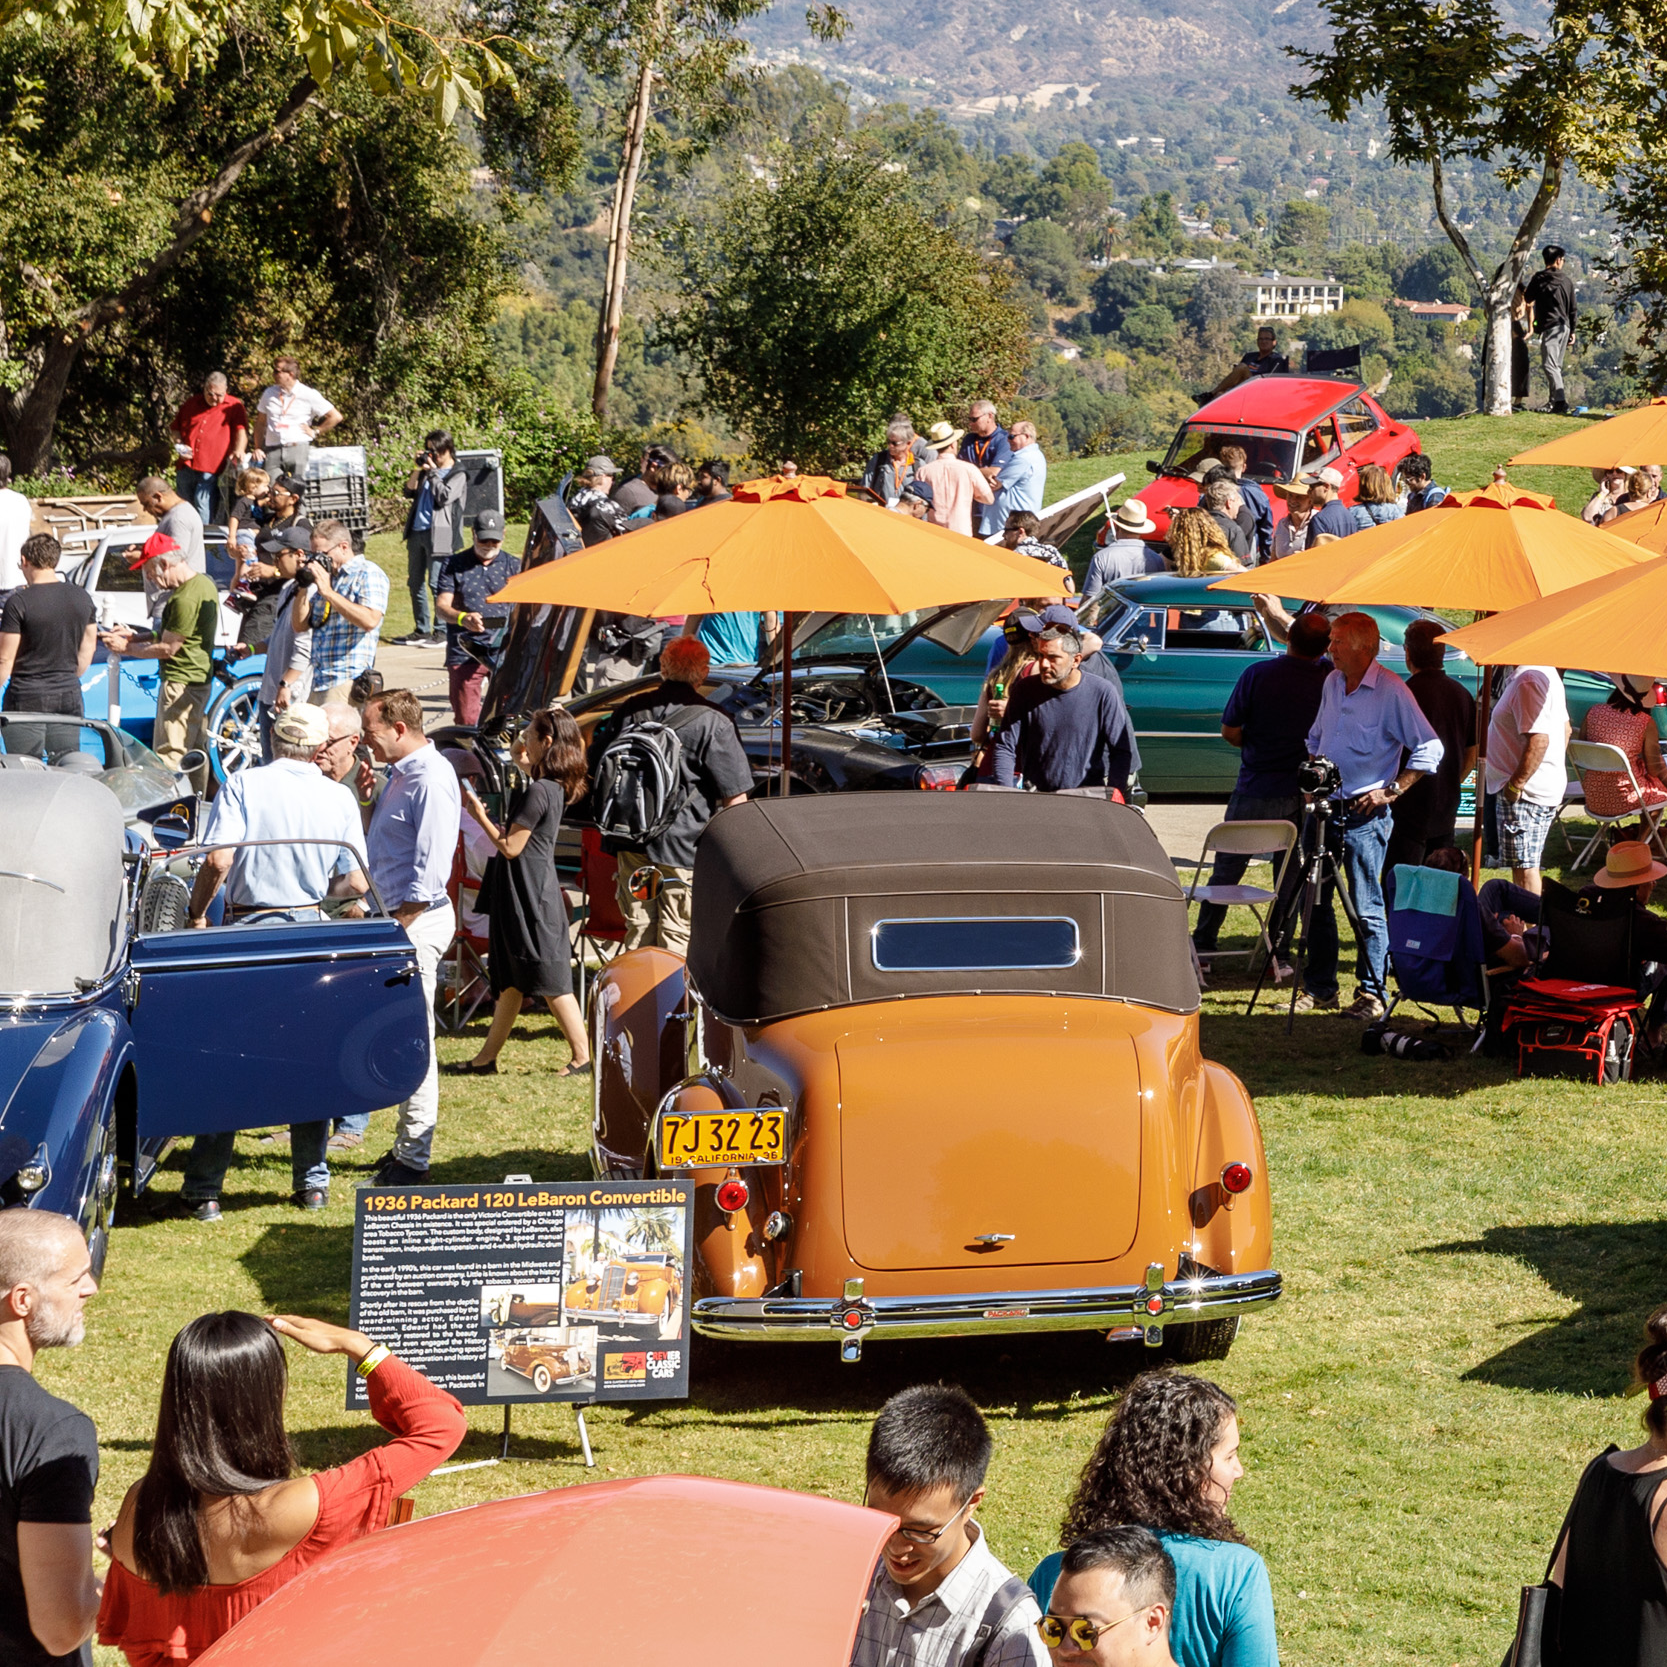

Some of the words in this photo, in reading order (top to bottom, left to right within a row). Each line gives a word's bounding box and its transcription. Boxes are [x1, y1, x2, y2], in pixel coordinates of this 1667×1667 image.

[666, 1120, 699, 1153] 7J
[710, 1119, 740, 1151] 32
[750, 1117, 780, 1149] 23
[671, 1156, 682, 1164] 19
[690, 1152, 755, 1163] CALIFORNIA
[364, 1195, 407, 1211] 1936
[411, 1193, 479, 1209] Packard
[483, 1193, 514, 1208] 120
[518, 1191, 586, 1207] LeBaron
[589, 1188, 686, 1205] Convertible
[646, 1350, 680, 1361] CREVIER
[646, 1360, 680, 1370] CLASSIC
[652, 1369, 674, 1378] CARS
